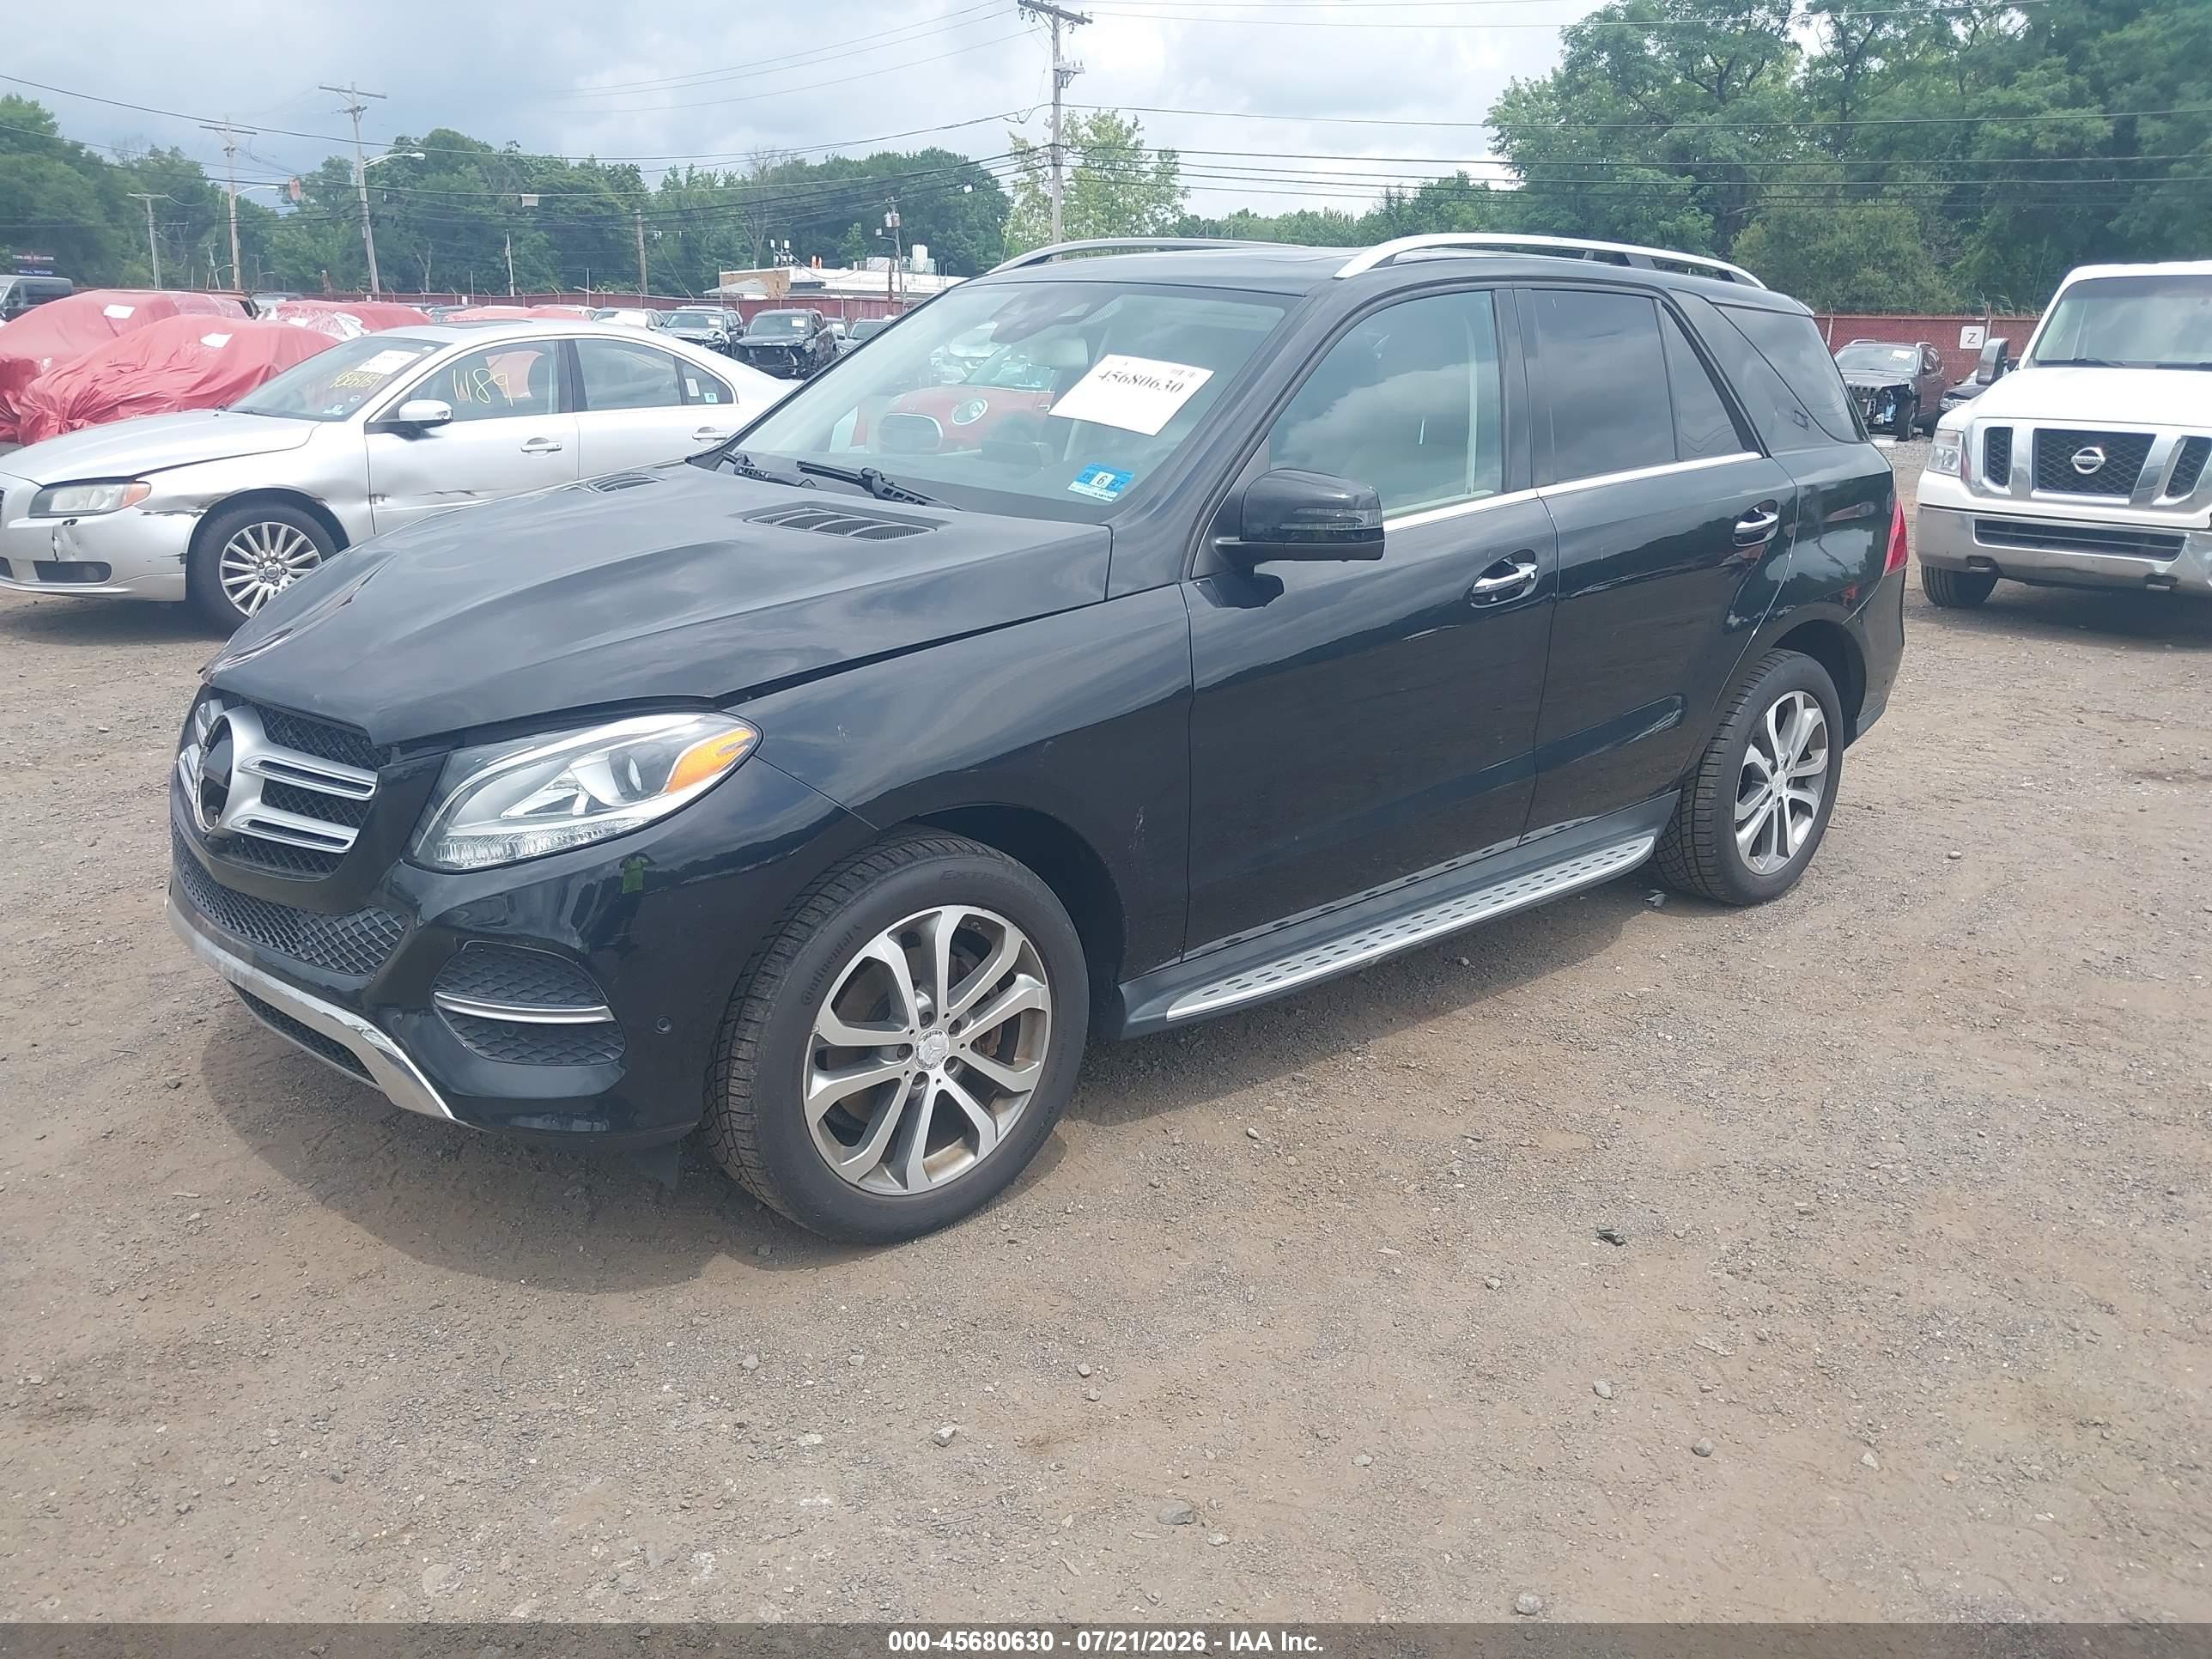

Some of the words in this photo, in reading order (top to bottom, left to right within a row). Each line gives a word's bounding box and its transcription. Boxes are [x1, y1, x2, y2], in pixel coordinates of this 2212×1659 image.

[1967, 332, 1977, 343] Z
[1098, 370, 1185, 393] 45680630
[1097, 475, 1108, 485] 6
